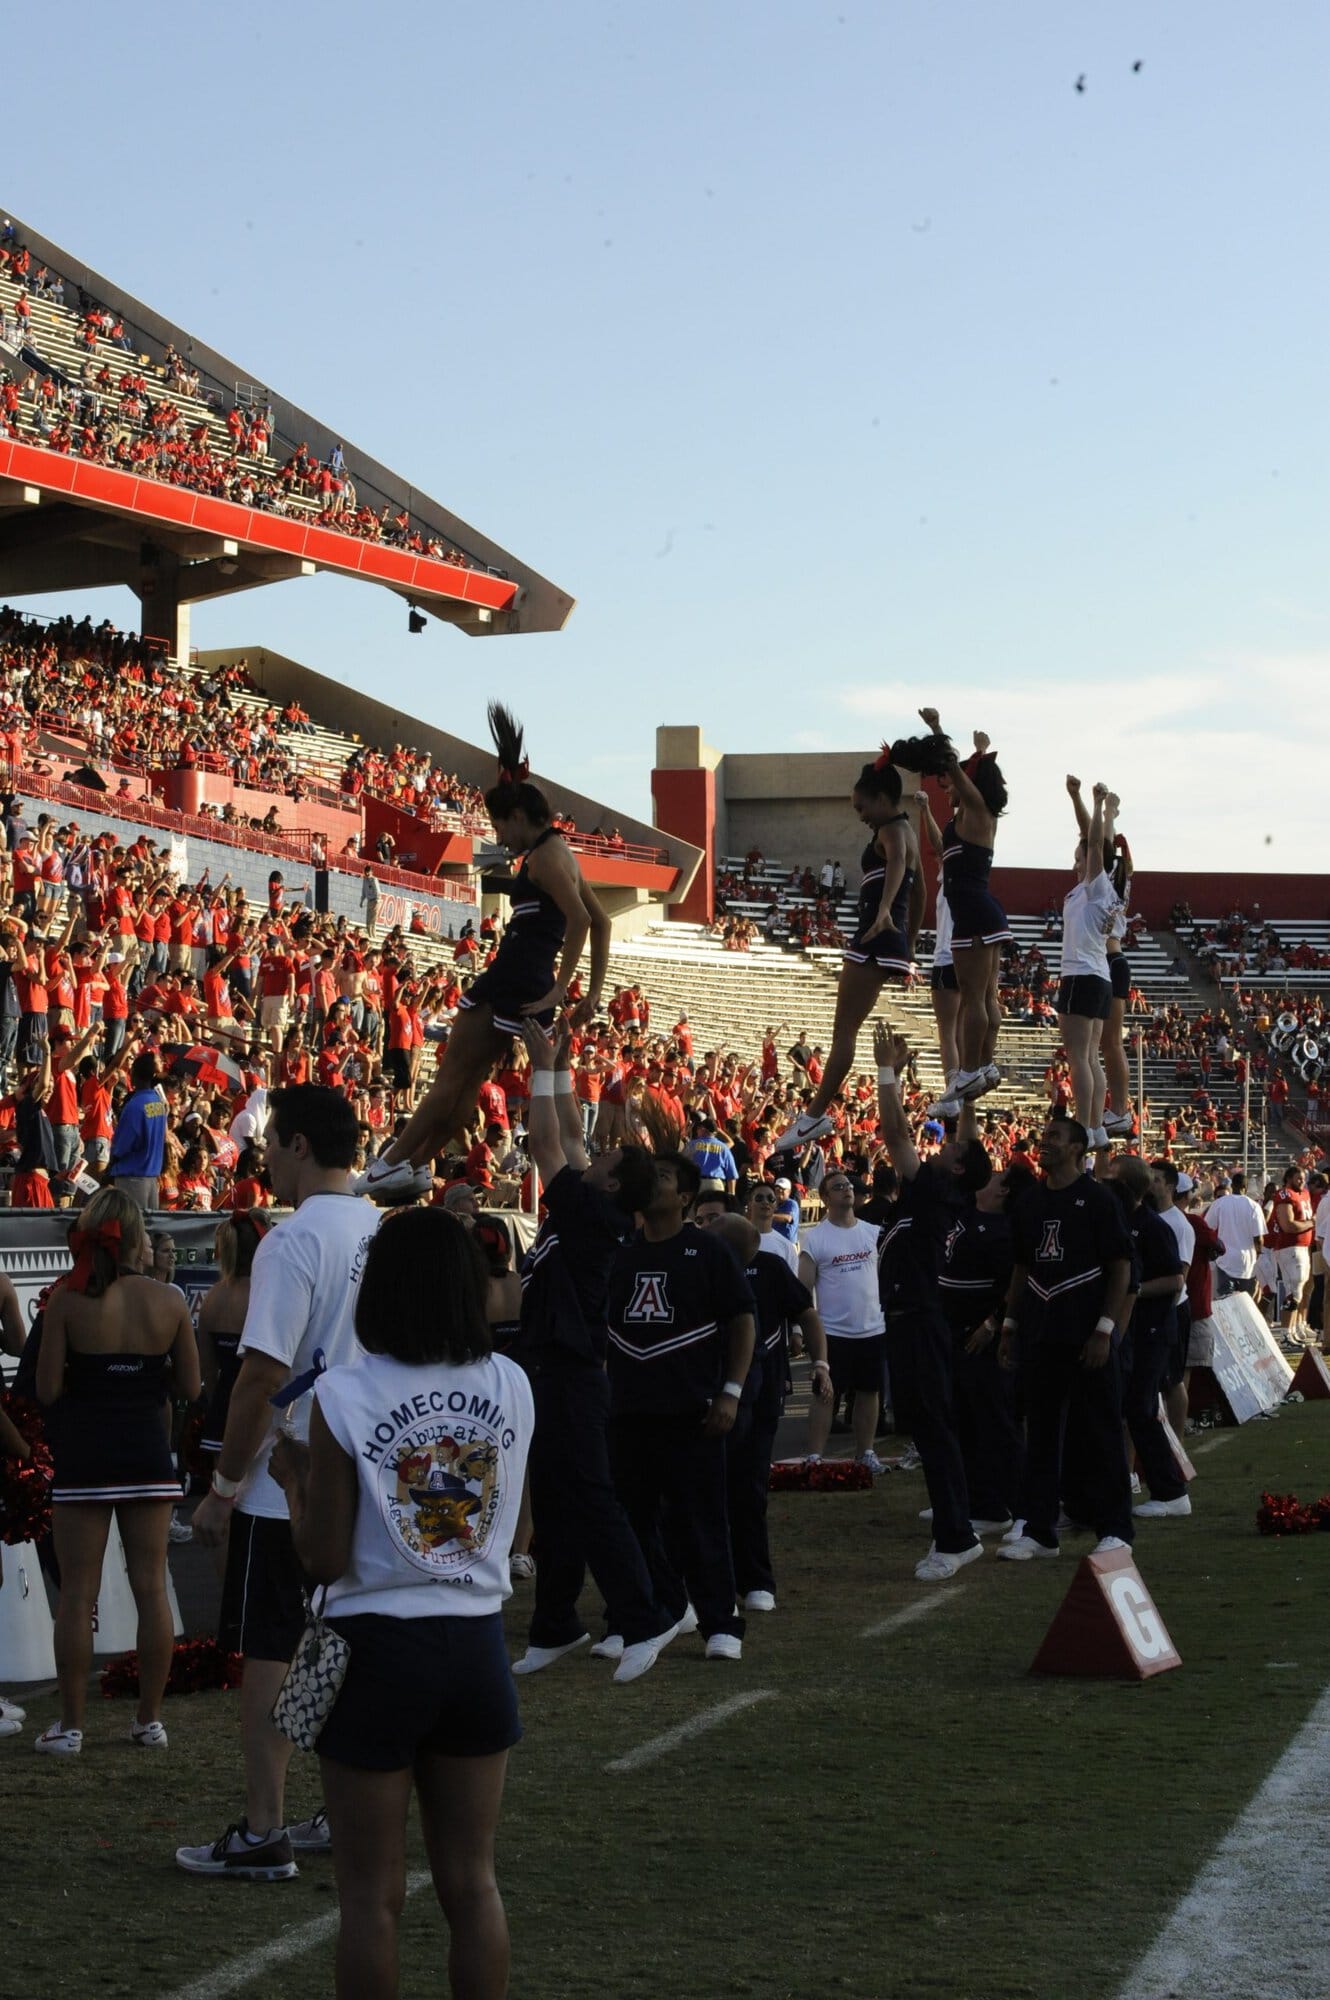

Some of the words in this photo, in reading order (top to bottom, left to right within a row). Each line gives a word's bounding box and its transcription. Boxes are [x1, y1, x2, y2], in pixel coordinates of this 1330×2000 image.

[376, 893, 412, 928] ZON
[831, 1250, 872, 1264] ARIZONA
[1035, 1220, 1064, 1262] A
[624, 1271, 675, 1324] A
[362, 1391, 516, 1463] HOMECOMING
[454, 1425, 477, 1443] at
[1110, 1576, 1171, 1659] G
